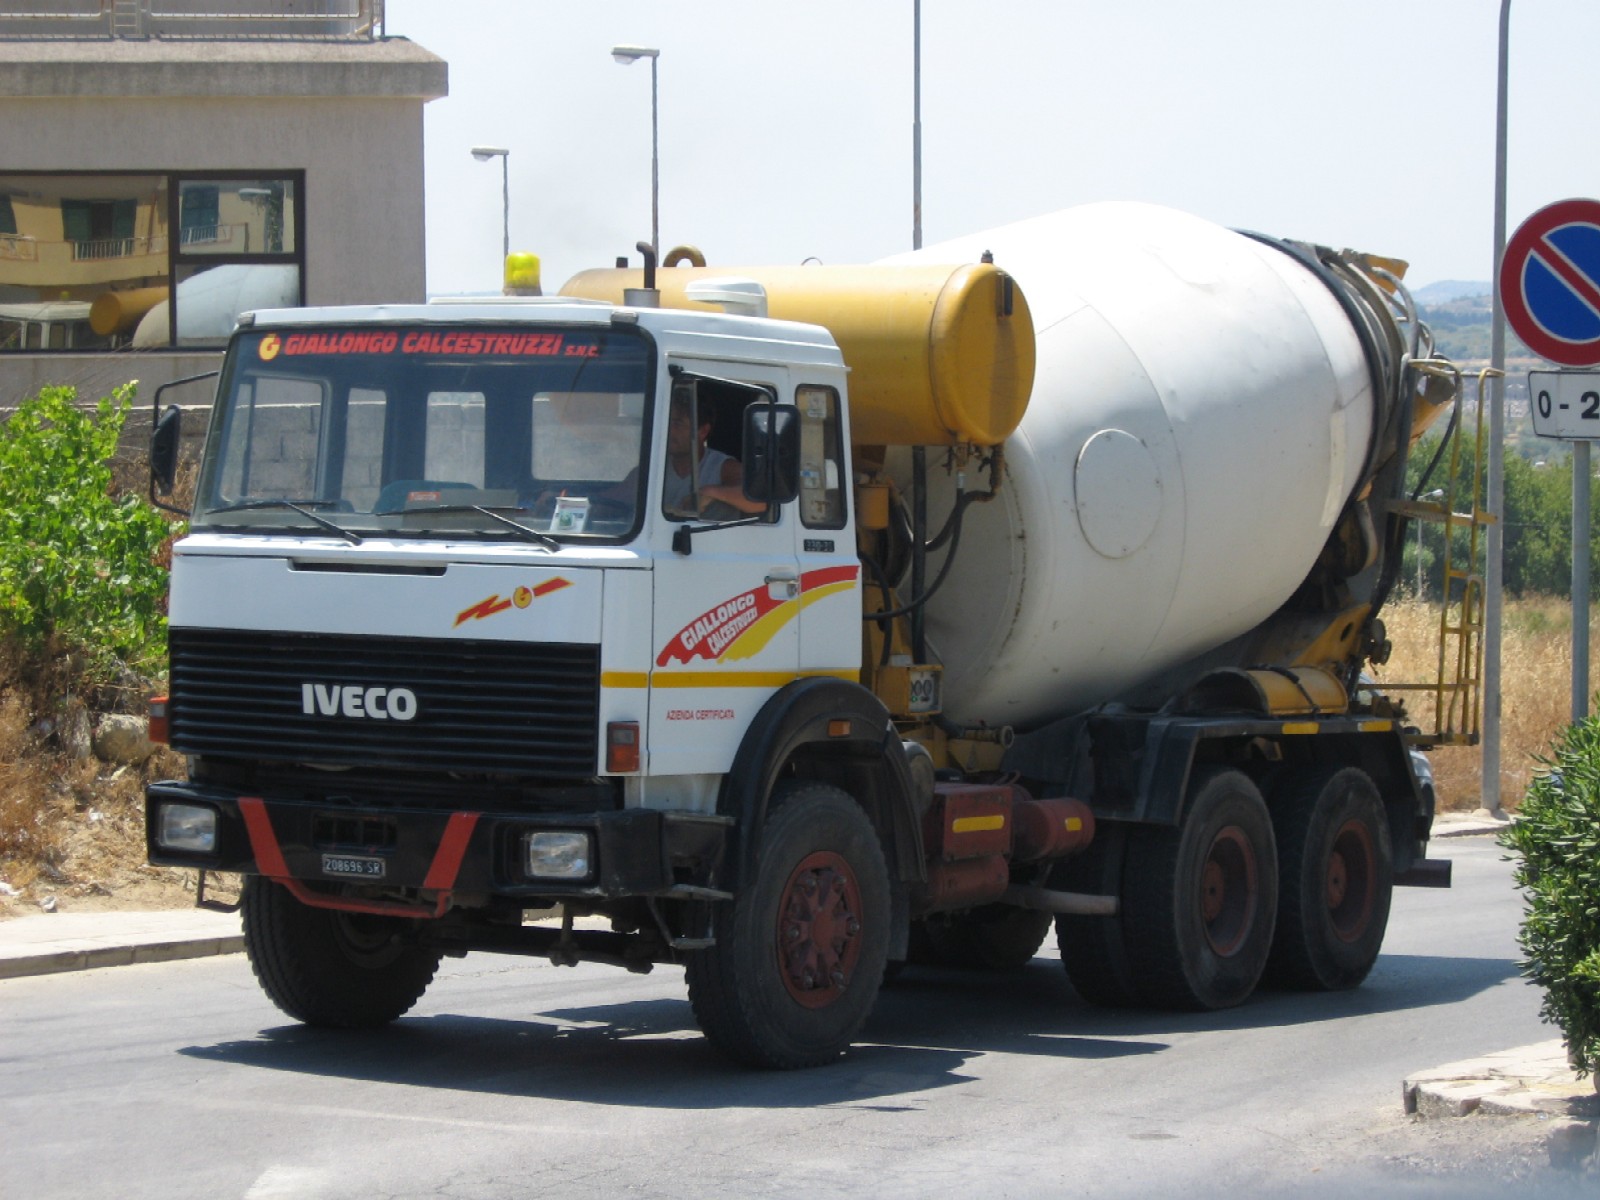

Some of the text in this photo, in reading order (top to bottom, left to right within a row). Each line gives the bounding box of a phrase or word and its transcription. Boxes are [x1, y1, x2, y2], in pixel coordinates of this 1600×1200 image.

[284, 332, 398, 355] GIALLONGO
[402, 332, 564, 355] CALCESTRUZZI
[1538, 390, 1552, 419] 0
[681, 594, 755, 650] GIALLONGO
[707, 606, 757, 655] CALCESTRUZZI
[302, 683, 417, 720] IVECO
[666, 709, 735, 720] AZIENDA CERTIFICATA
[326, 859, 380, 873] 208696 SR
